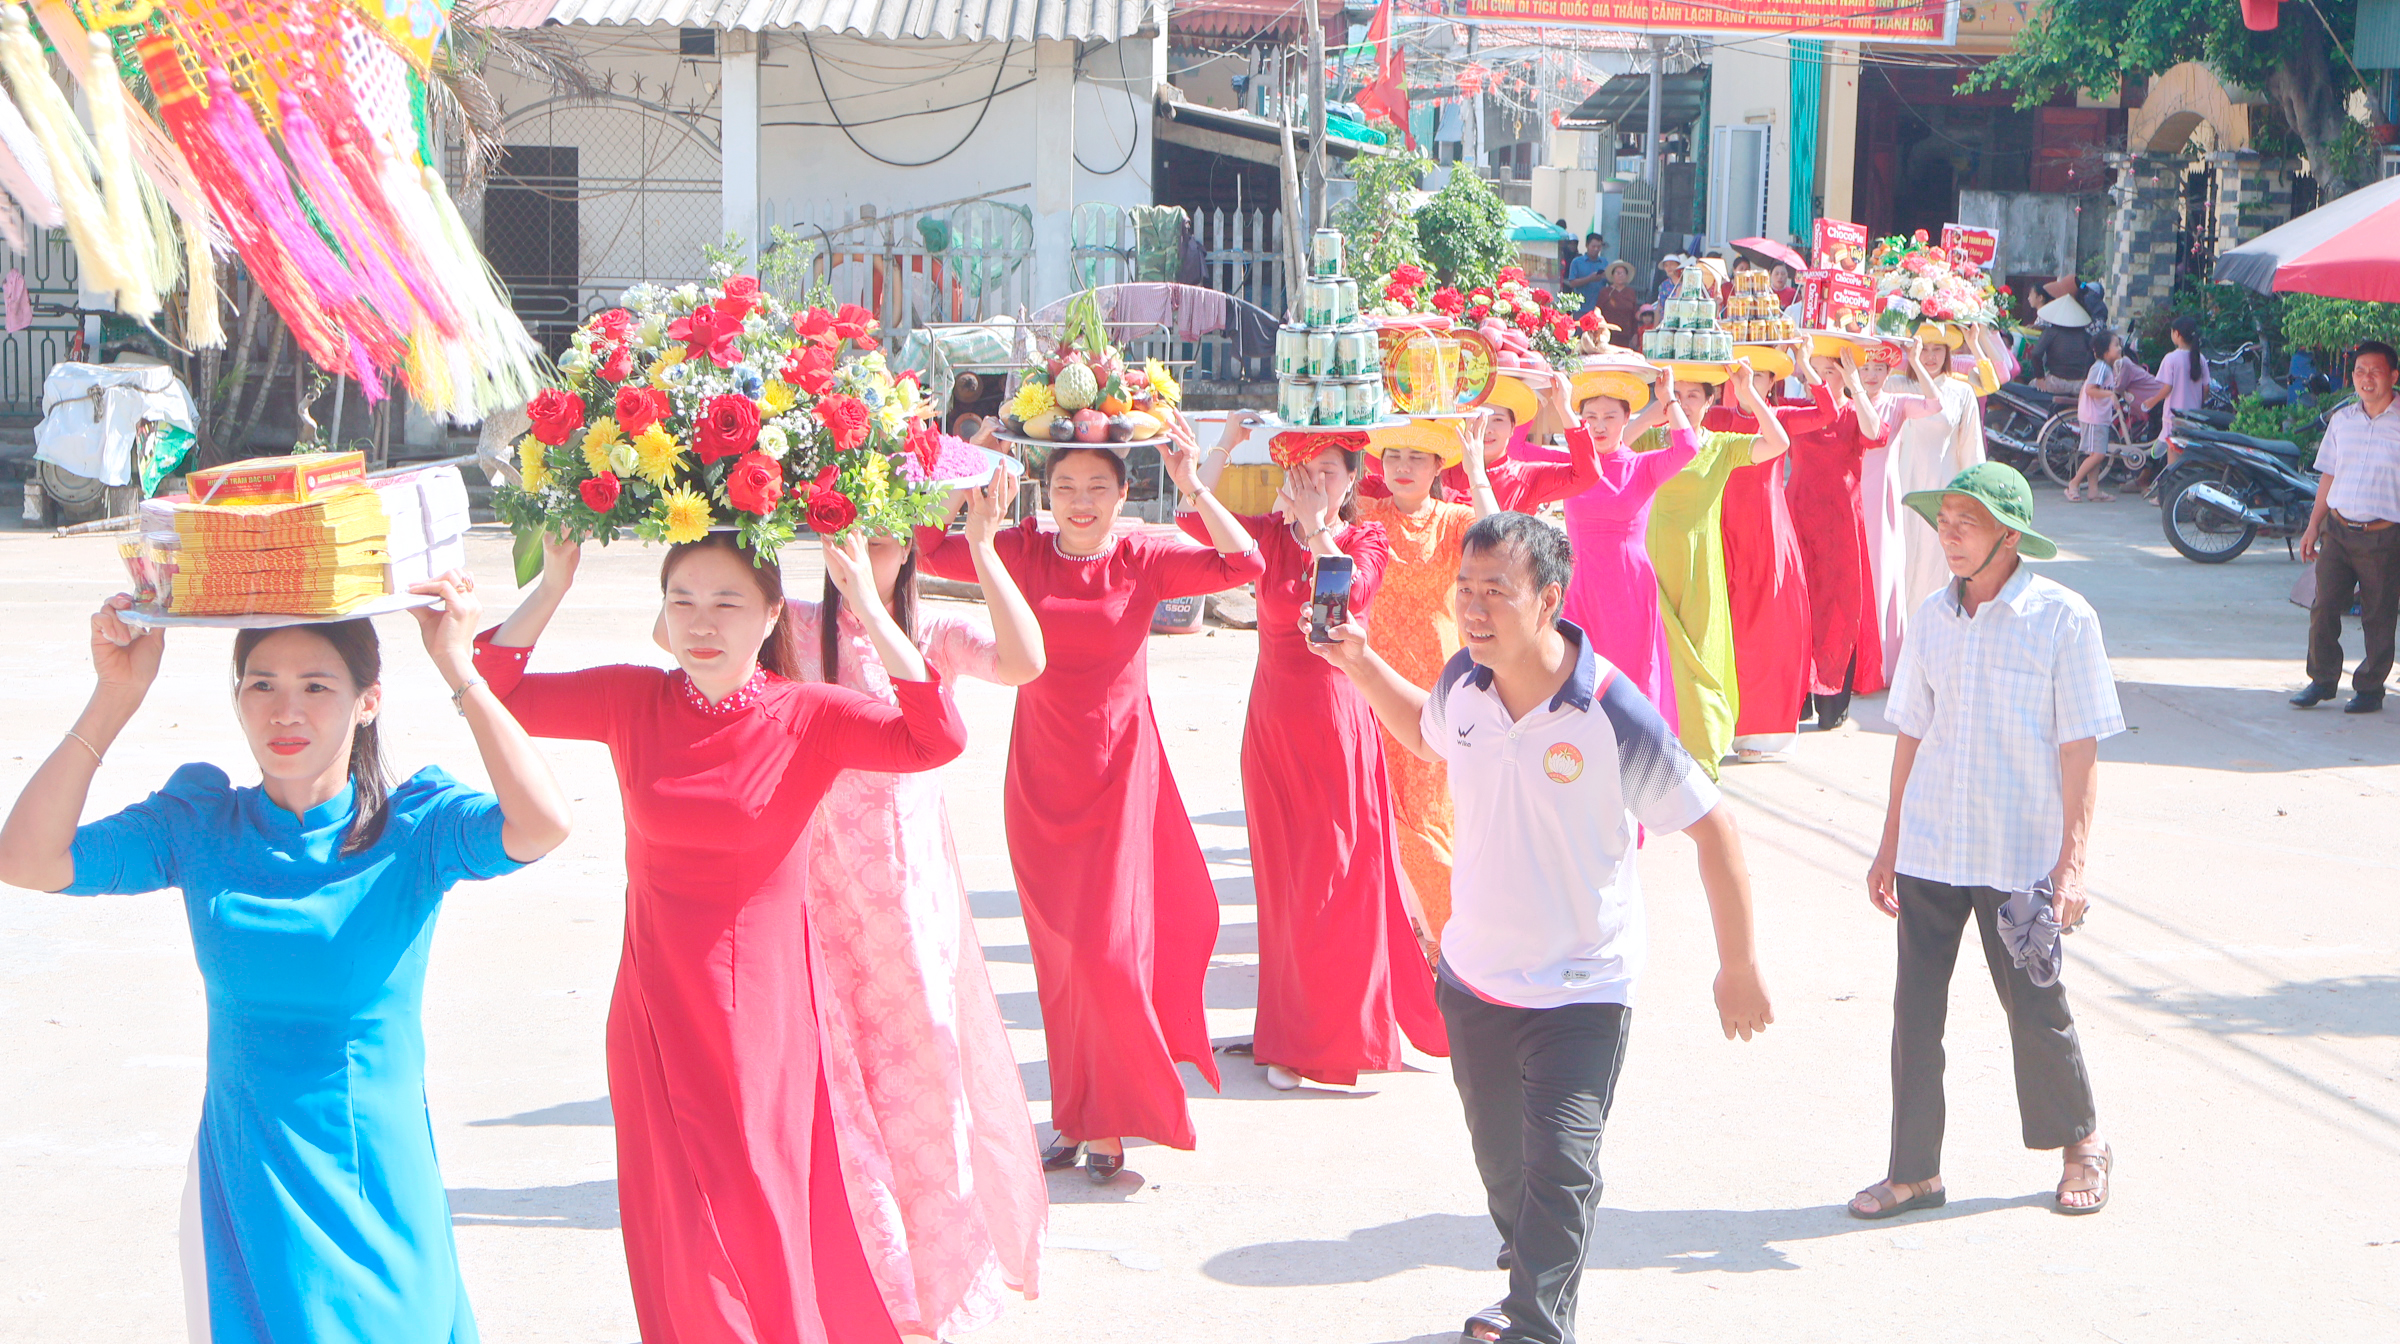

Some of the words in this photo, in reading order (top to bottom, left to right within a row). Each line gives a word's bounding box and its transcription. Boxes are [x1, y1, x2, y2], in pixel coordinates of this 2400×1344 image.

[1471, 0, 1488, 13] TẠI
[1492, 0, 1515, 15] CỤM
[1519, 2, 1529, 13] DI
[1533, 0, 1556, 14] TÍCH
[1560, 2, 1589, 17] QUỐC
[1592, 7, 1610, 17] GIA
[1613, 4, 1649, 20] THẮNG
[1652, 6, 1682, 21] CẢNH
[1685, 8, 1712, 24] LẠCH
[1715, 11, 1746, 25] BẠNG
[1748, 9, 1792, 25] PHƯỜNG
[1875, 17, 1909, 30] THANH
[1912, 17, 1934, 31] HÓA
[1827, 226, 1864, 244] ChocoPie
[1833, 291, 1870, 308] ChocoPie
[207, 478, 229, 487] HƯNG
[1165, 603, 1191, 613] 6500
